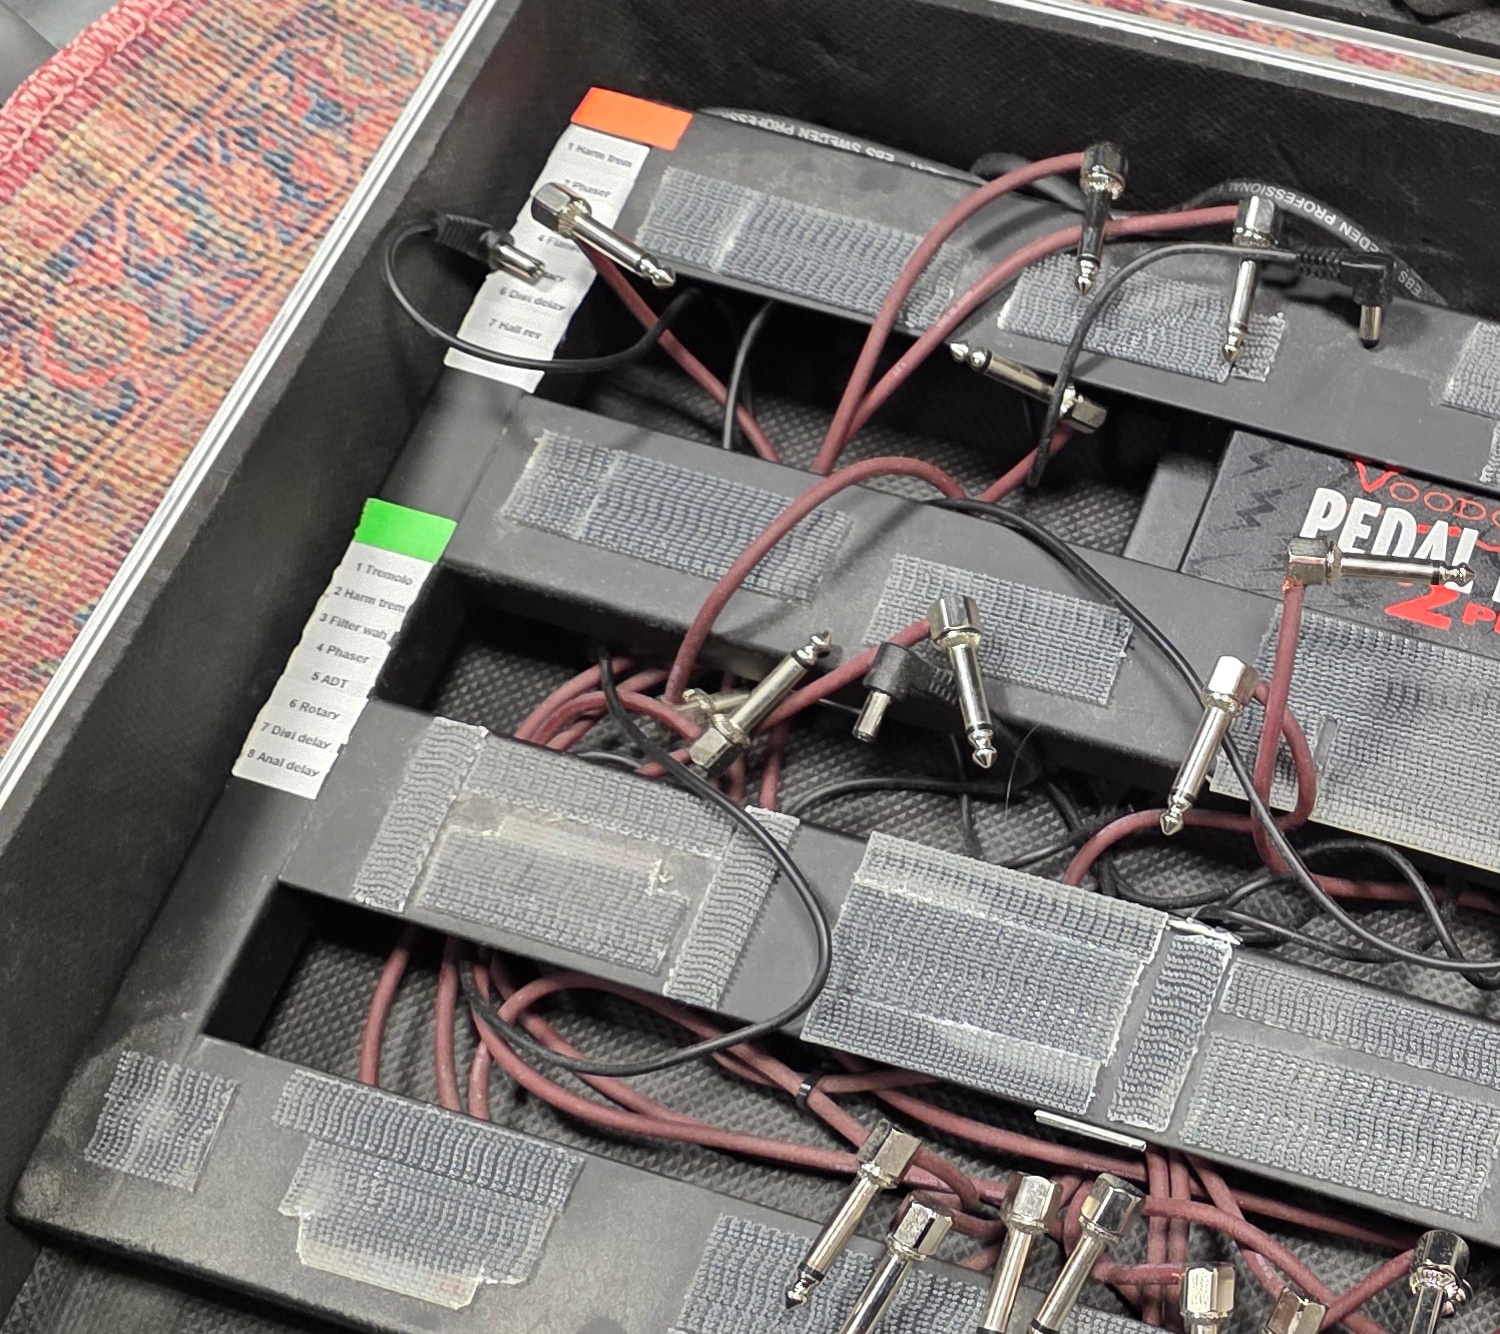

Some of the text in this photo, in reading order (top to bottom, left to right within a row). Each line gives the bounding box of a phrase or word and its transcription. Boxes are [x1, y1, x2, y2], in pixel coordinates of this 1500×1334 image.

[1228, 182, 1338, 227] PROFESSIONAL
[1397, 269, 1424, 299] EBS
[1299, 487, 1480, 595] PEDAL
[356, 563, 413, 586] 1 Tremolo
[334, 586, 405, 613] 2 Harm trem
[319, 612, 388, 640] 3 Filter wah
[316, 643, 371, 664] 4 Phaser
[311, 671, 350, 689] 5 ADT
[289, 699, 341, 720] 6 Rotary
[260, 722, 271, 732] 7
[297, 733, 332, 749] delay
[247, 748, 320, 777] 8 Anal delay
